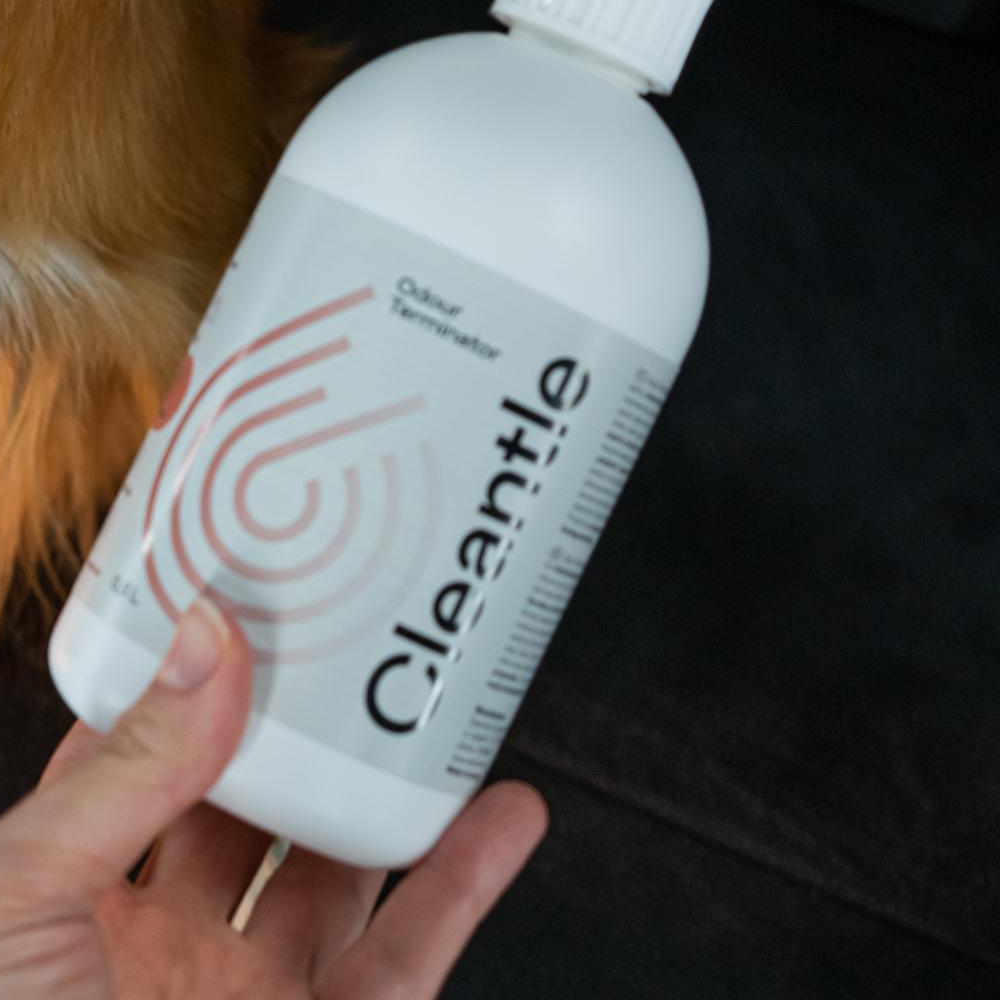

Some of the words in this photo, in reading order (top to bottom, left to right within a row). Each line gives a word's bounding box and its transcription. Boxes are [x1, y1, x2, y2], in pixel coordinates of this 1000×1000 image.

[390, 294, 502, 361] Terminator
[396, 275, 463, 317] Odour
[363, 356, 592, 735] Cleantle
